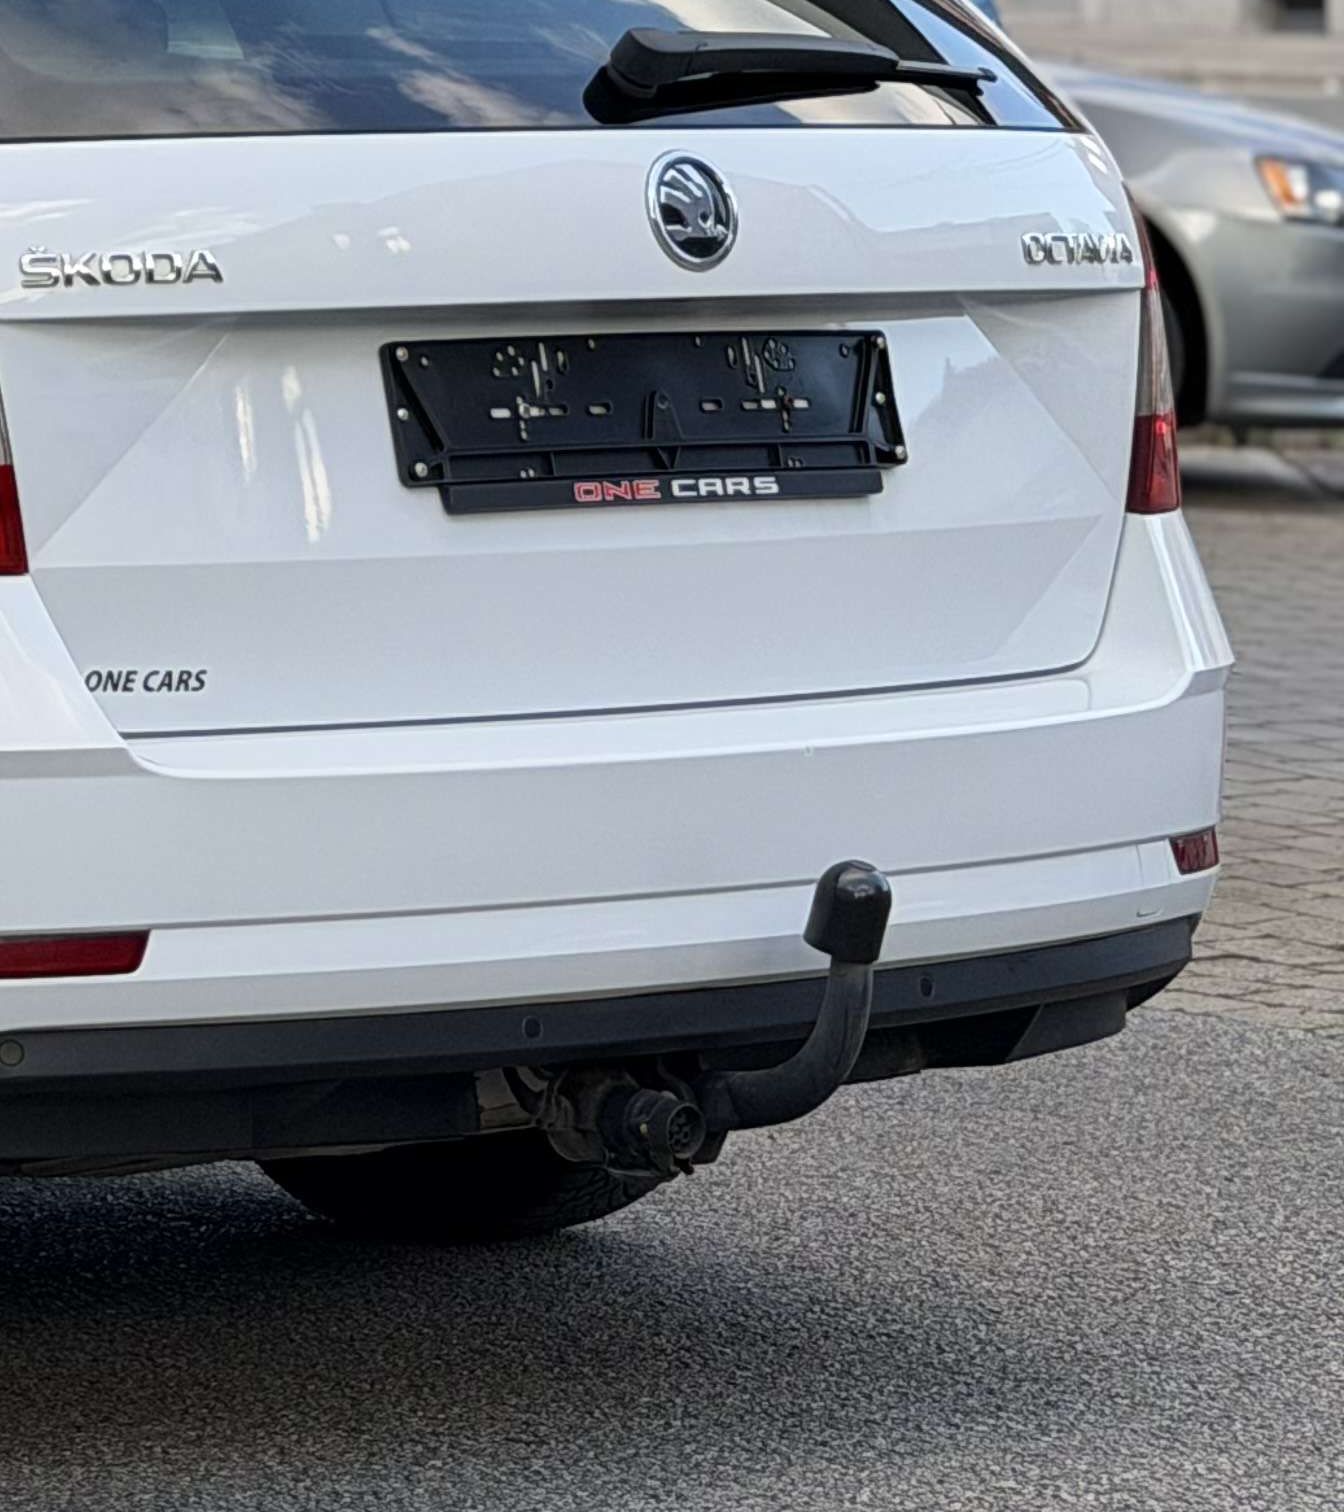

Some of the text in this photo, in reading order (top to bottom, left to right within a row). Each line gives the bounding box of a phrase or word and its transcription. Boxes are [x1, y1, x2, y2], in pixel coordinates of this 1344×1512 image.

[19, 245, 224, 289] ŠKODA
[574, 476, 780, 502] ONE CARS
[84, 669, 208, 693] ONE CARS
